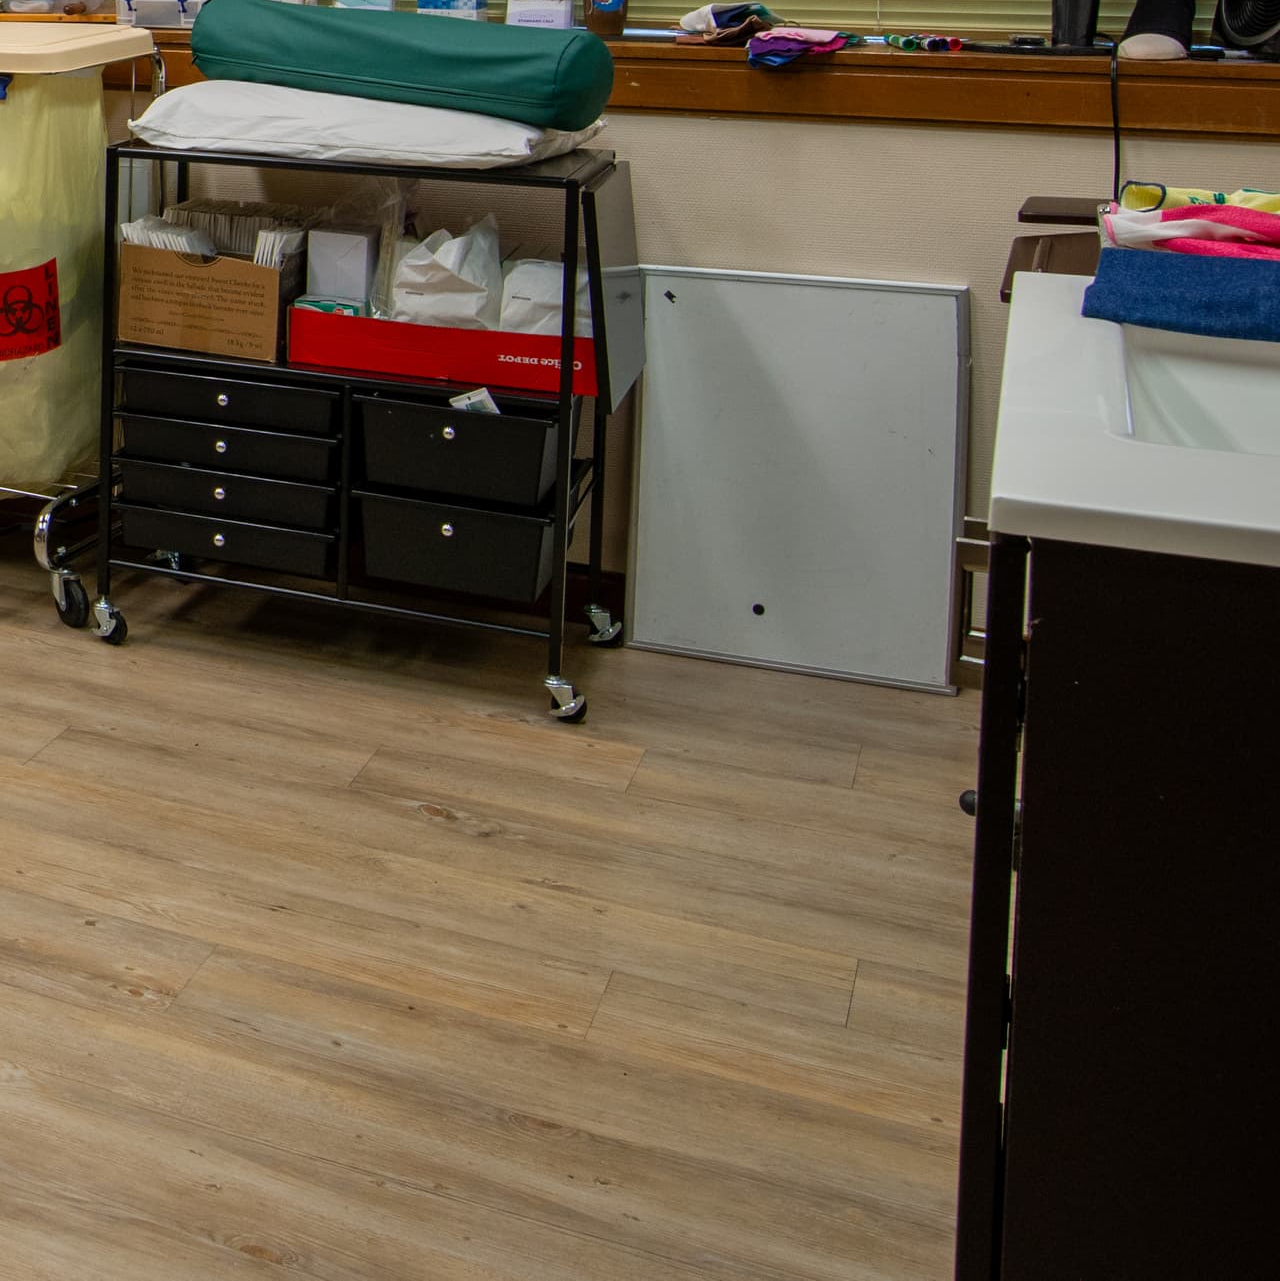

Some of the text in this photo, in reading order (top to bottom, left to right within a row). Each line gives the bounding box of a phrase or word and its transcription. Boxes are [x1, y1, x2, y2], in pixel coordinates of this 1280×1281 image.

[44, 266, 59, 350] LINEN
[497, 354, 582, 371] Oice DEPOT
